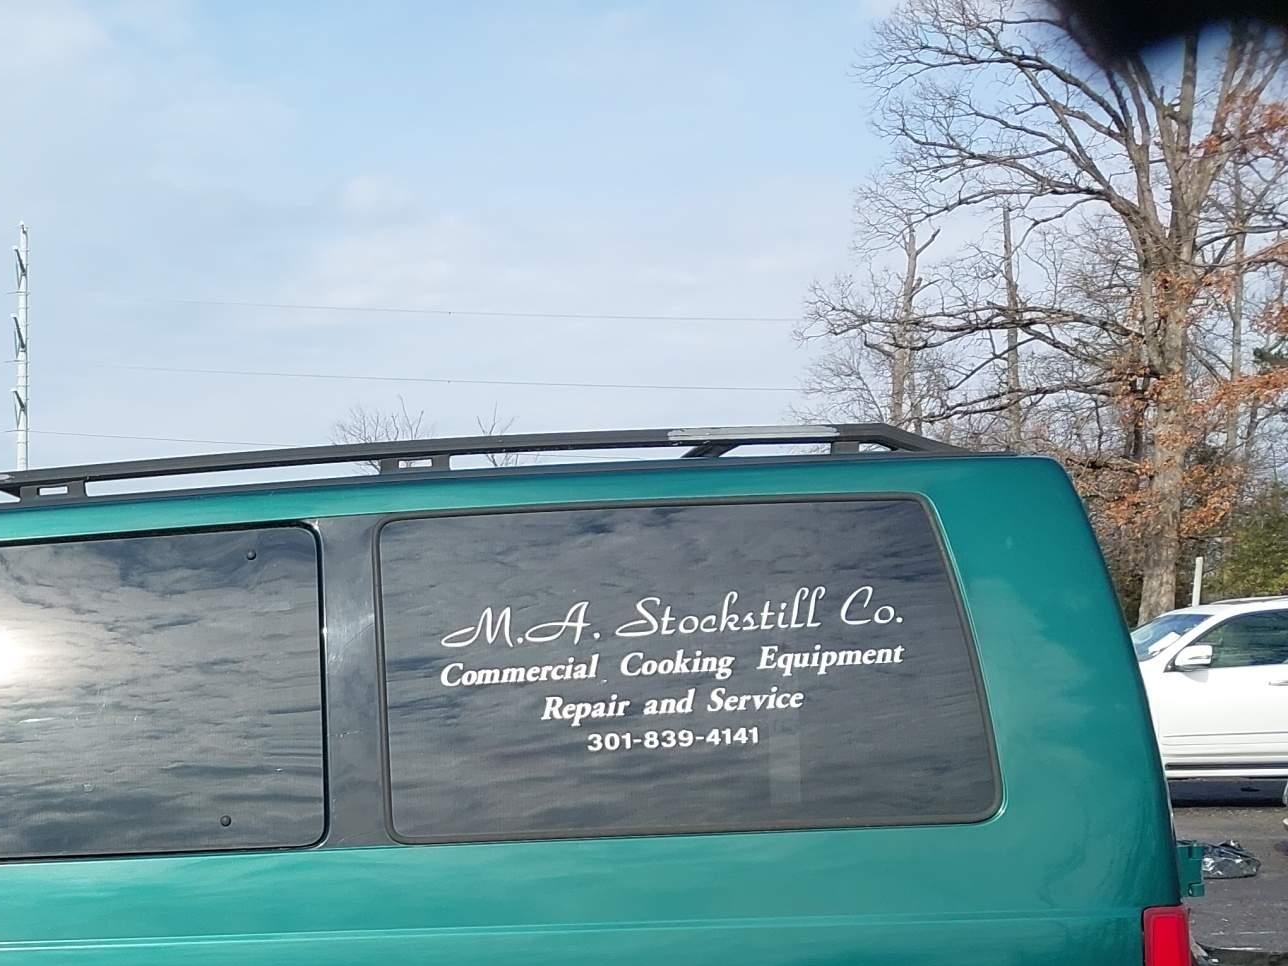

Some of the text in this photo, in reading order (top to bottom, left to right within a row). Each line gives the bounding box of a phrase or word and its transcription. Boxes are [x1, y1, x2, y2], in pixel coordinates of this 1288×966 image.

[440, 585, 905, 648] M.A. Stockstill Co.
[439, 643, 906, 688] Commercial Cooking Equipment
[540, 687, 805, 728] Repair and Service
[586, 725, 760, 752] 301-839-4141
